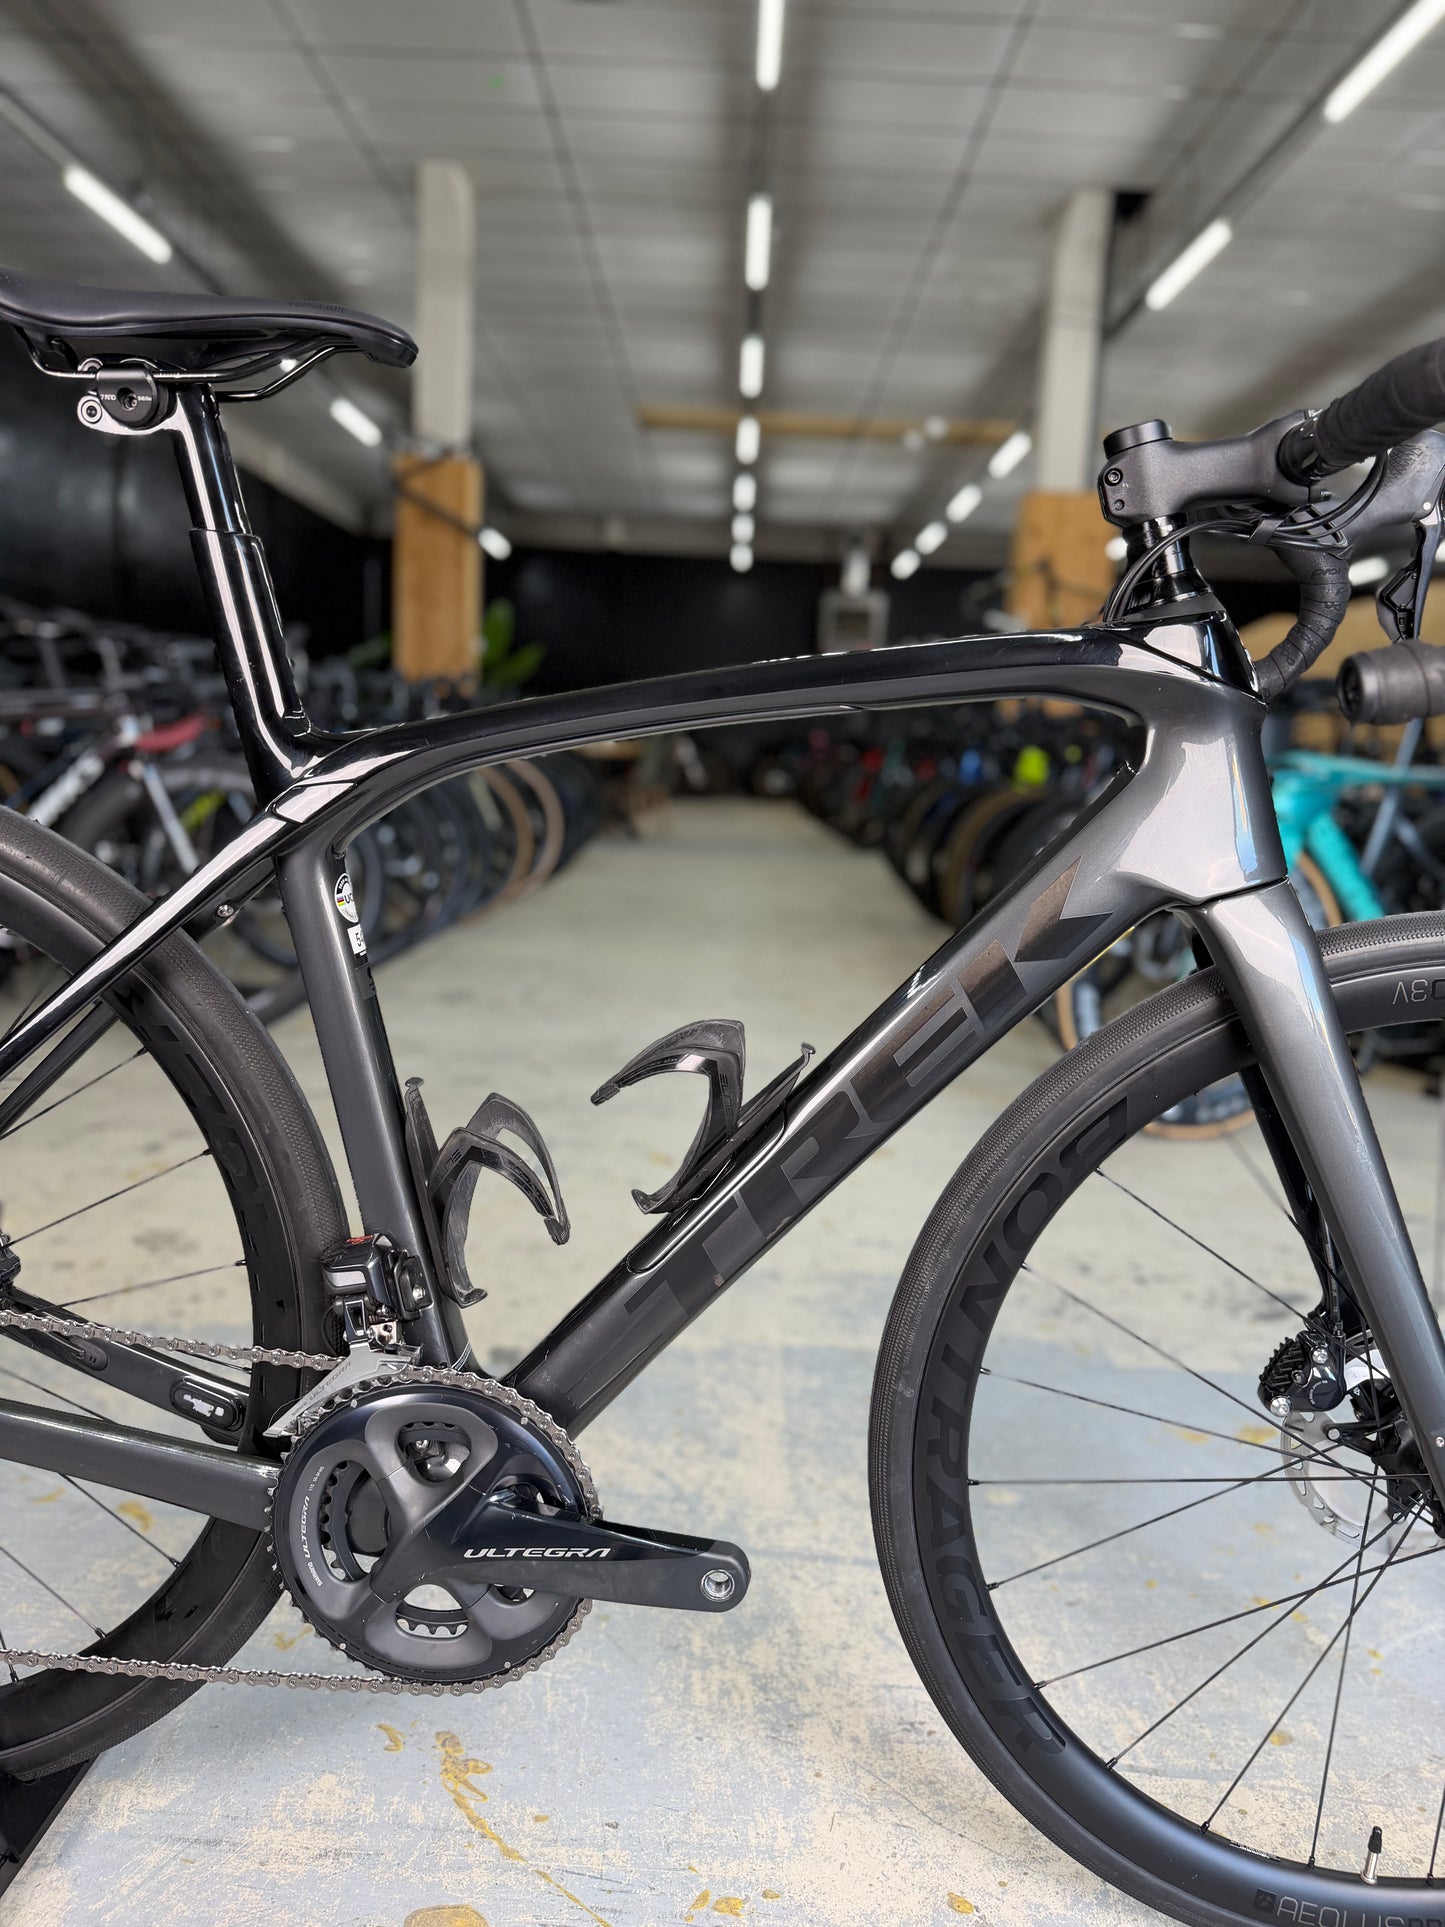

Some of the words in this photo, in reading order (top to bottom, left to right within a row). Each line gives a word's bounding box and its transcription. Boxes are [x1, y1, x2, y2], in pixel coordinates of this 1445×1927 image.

[624, 856, 1113, 1316] TREK
[301, 1496, 311, 1559] ULTEGRA
[464, 1547, 612, 1559] ULTEGRA
[925, 1096, 1128, 1757] BONTRAGER
